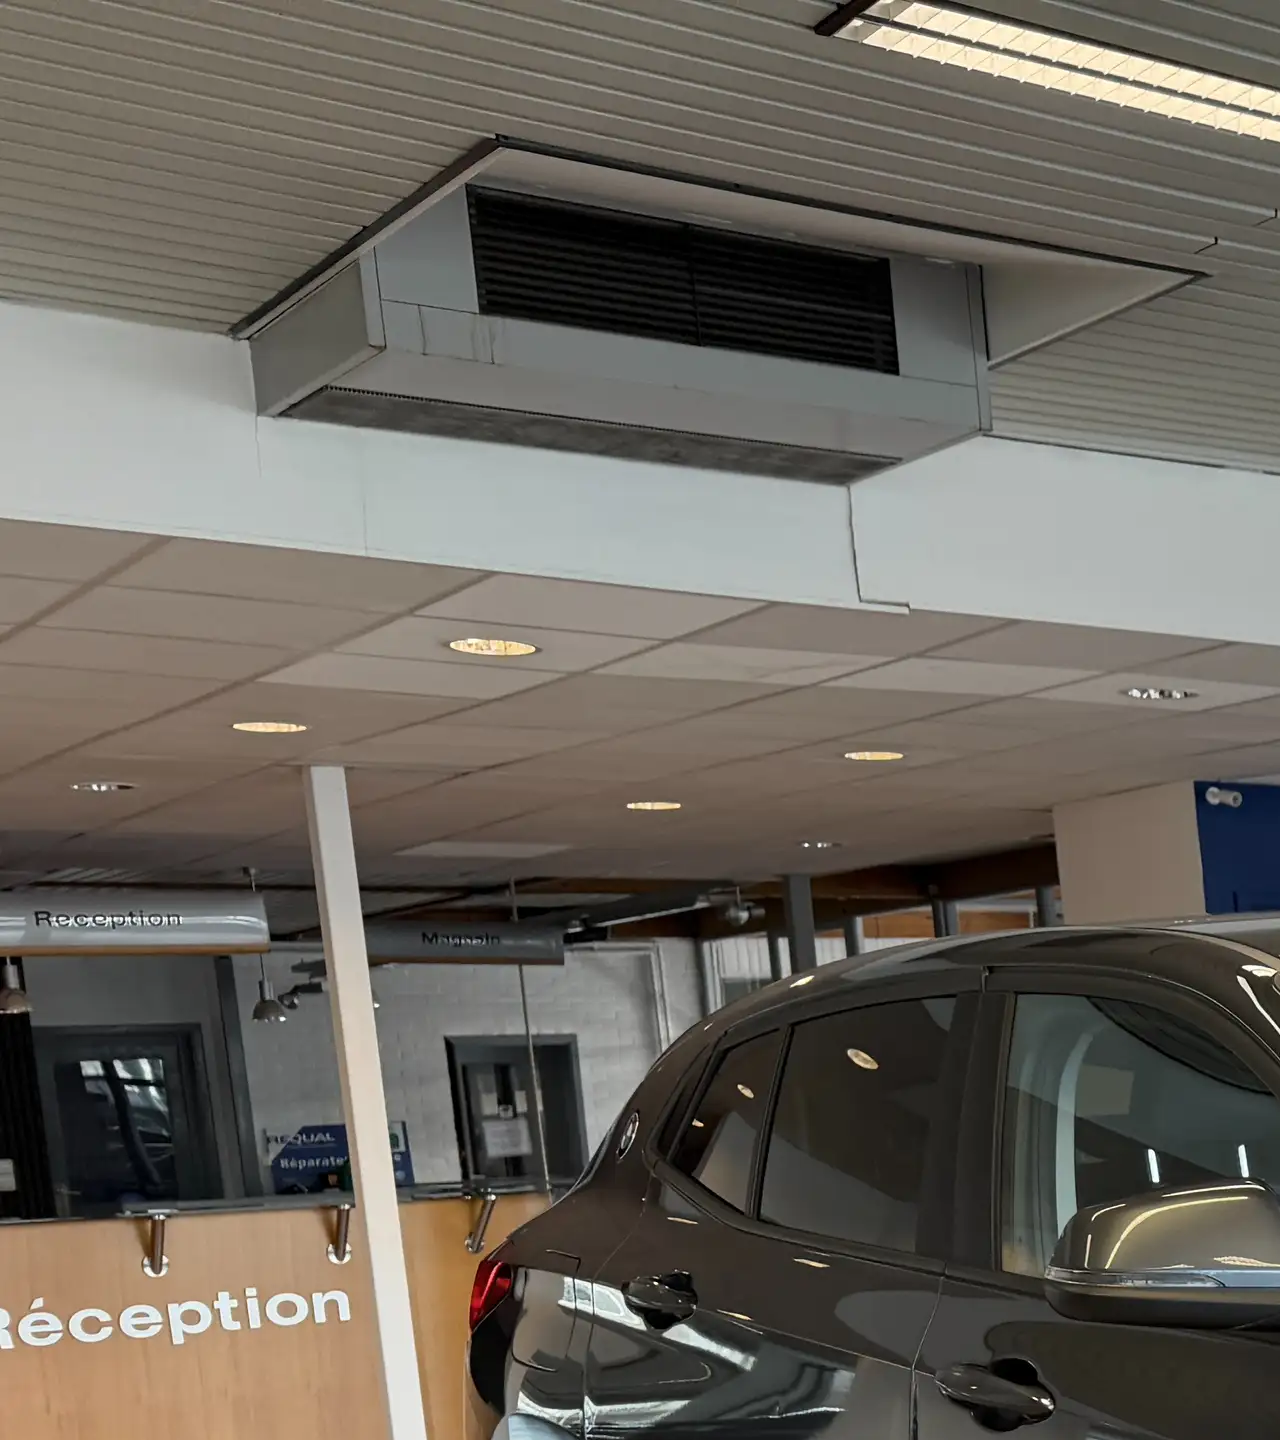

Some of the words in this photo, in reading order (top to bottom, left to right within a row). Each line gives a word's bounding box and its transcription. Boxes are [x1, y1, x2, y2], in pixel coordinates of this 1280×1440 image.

[34, 909, 183, 928] Reception
[421, 932, 501, 946] Magasin
[0, 1287, 351, 1350] Réception
